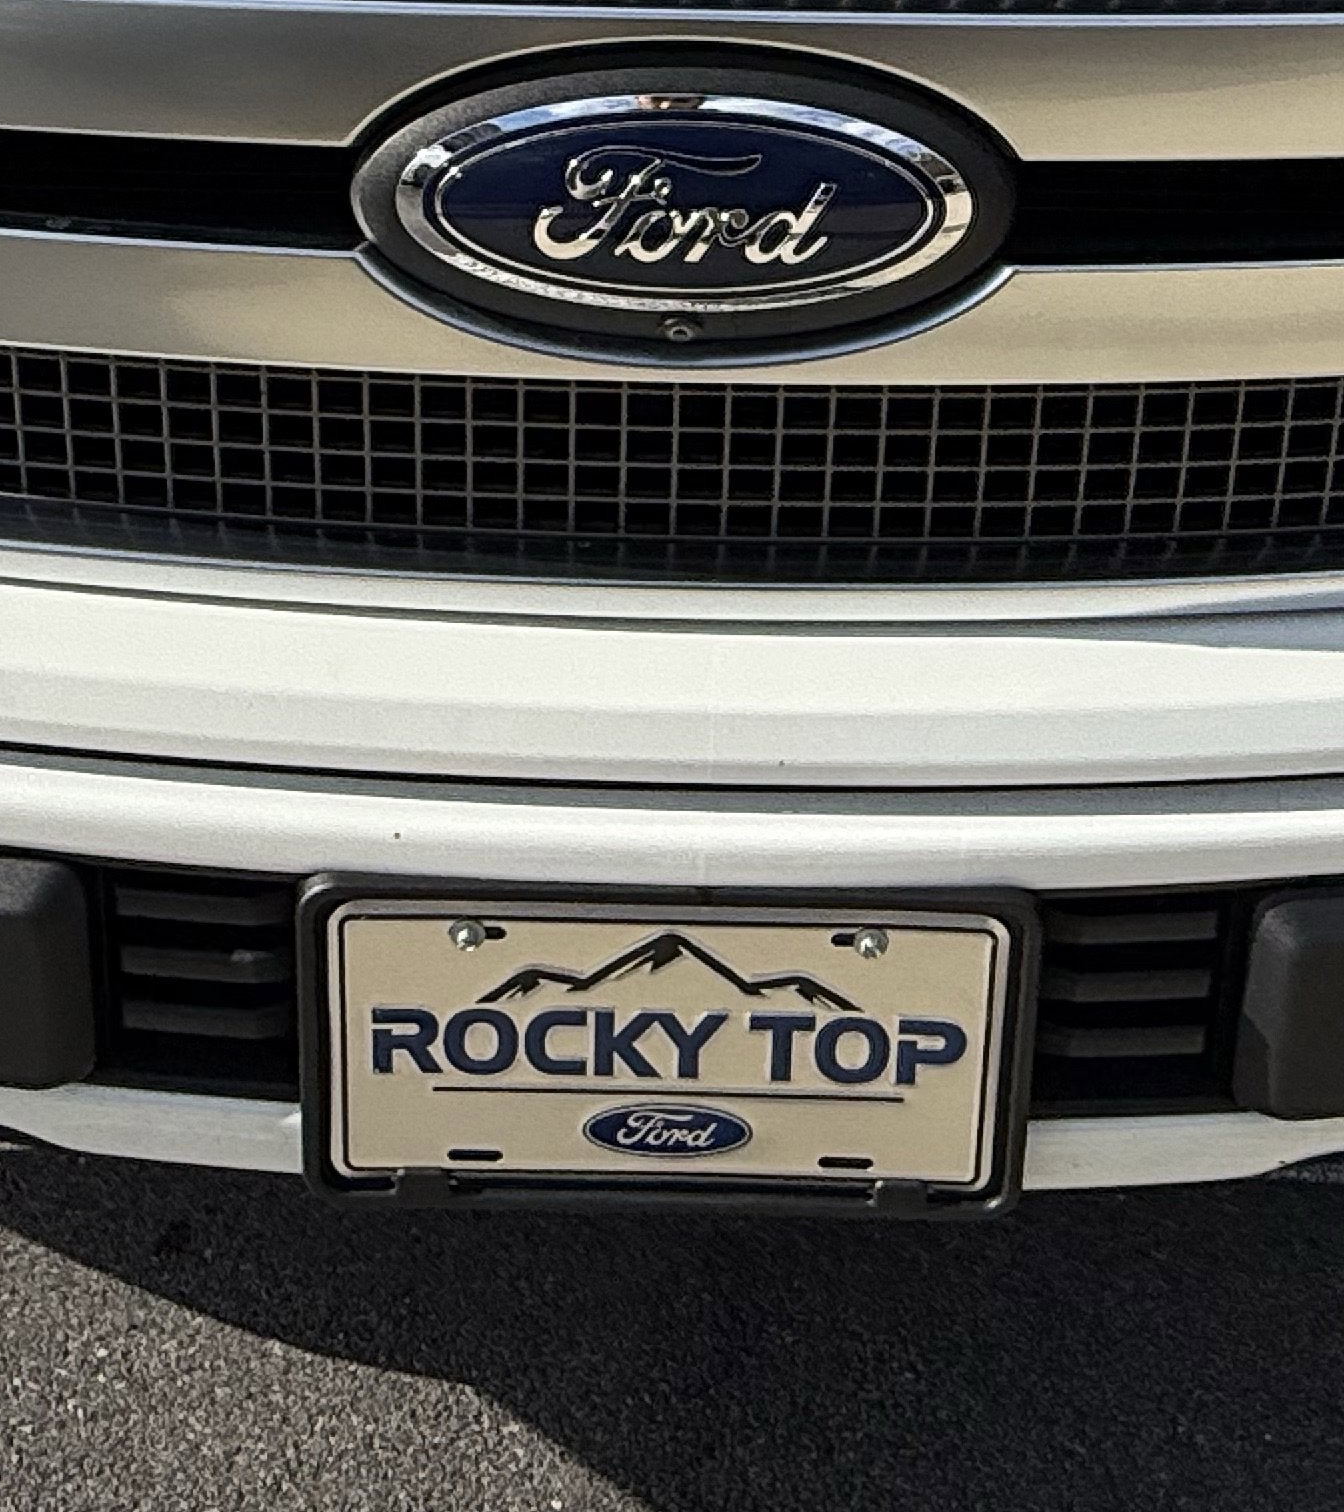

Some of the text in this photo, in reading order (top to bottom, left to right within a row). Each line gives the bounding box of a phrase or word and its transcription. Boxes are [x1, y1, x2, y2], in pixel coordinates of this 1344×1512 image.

[533, 144, 839, 264] Ford
[371, 1005, 969, 1085] ROCKY TOP
[616, 1111, 716, 1150] Ford
